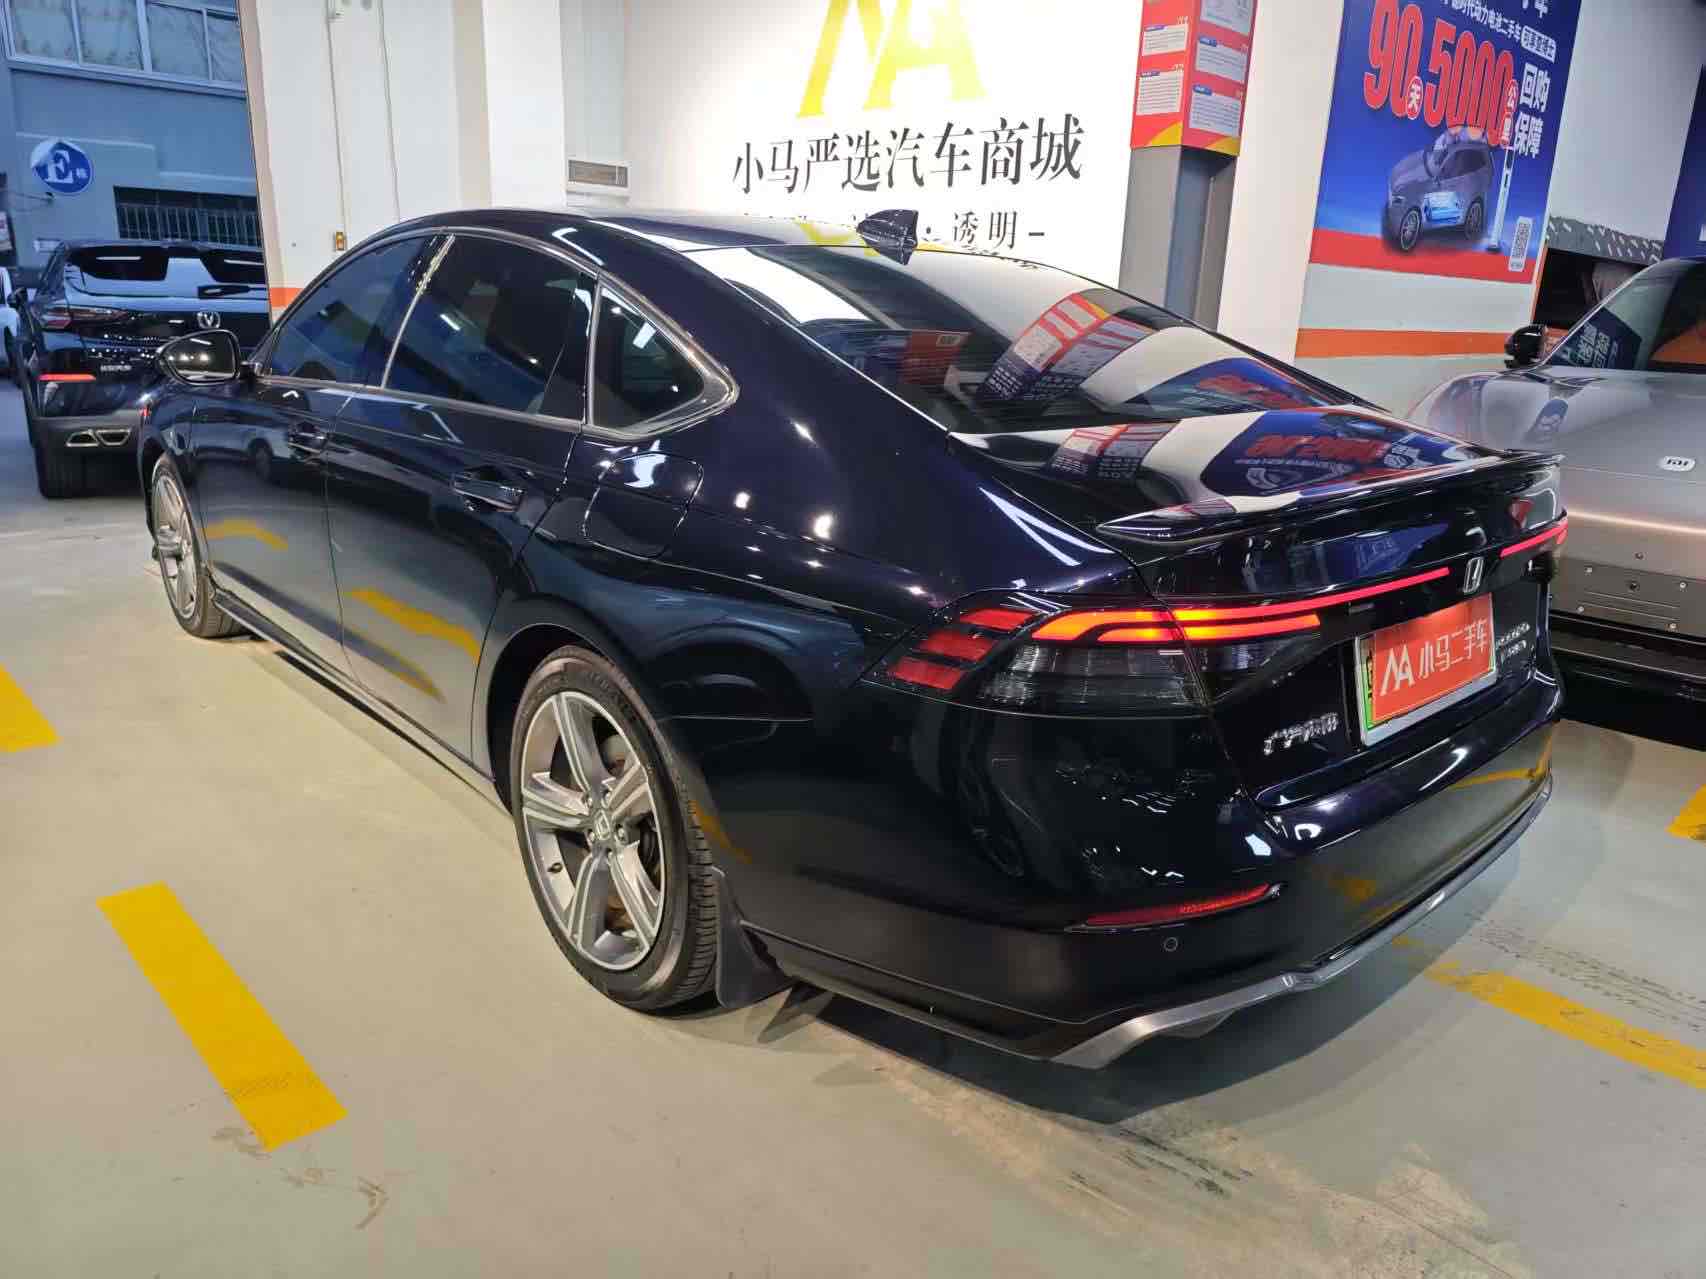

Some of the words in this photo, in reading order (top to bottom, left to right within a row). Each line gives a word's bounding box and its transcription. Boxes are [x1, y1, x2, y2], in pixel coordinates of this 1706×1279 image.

[1520, 62, 1551, 112] 回购
[732, 113, 1086, 194] 小马严选汽车商城
[1514, 112, 1544, 159] 保障
[1418, 617, 1488, 679] 小马二手车
